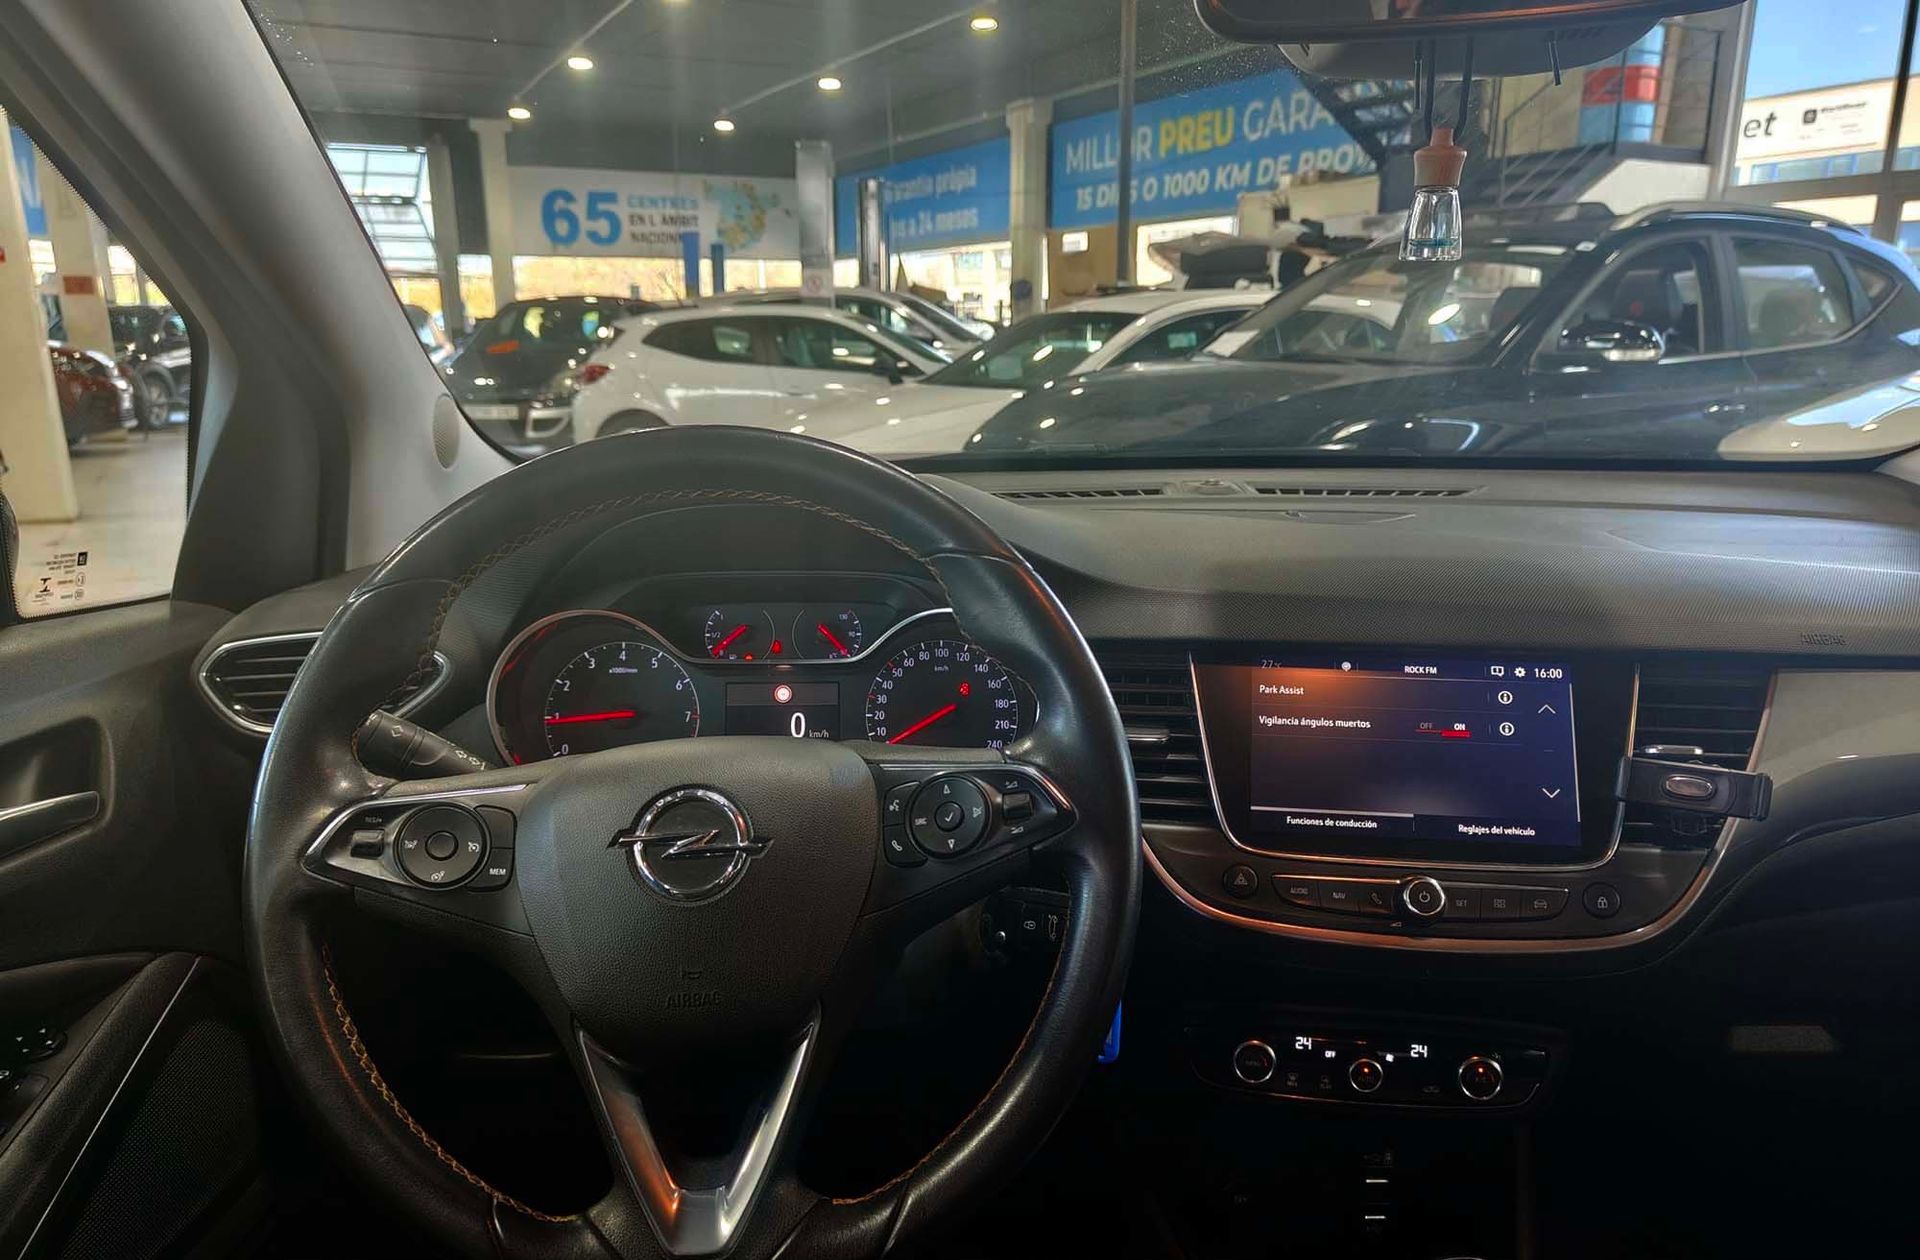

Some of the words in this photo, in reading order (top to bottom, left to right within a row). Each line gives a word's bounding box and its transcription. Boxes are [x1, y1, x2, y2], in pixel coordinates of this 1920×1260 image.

[1065, 126, 1153, 175] MILLR
[1159, 107, 1235, 158] PREU
[1164, 168, 1208, 199] 1000
[1214, 161, 1249, 190] KM
[1257, 155, 1291, 184] DE
[541, 188, 622, 246] 65
[619, 650, 626, 662] 4
[919, 651, 930, 661] 80
[935, 648, 949, 658] 100
[956, 652, 970, 662] 120
[588, 657, 596, 669] 3
[651, 657, 659, 669] 5
[904, 657, 915, 668] 60
[974, 663, 989, 673] 140
[892, 668, 903, 678] 50
[1404, 665, 1425, 674] ROCK
[1425, 666, 1437, 675] FM
[1534, 668, 1563, 679] 16:00
[563, 680, 571, 692] 2
[675, 680, 683, 691] 6
[882, 680, 893, 690] 40
[988, 679, 1001, 689] 160
[1259, 684, 1278, 695] Park
[1279, 685, 1304, 695] Assist
[876, 695, 888, 705] 30
[995, 698, 1009, 708] 180
[685, 711, 691, 723] 7
[874, 710, 885, 720] 20
[790, 712, 806, 738] 0
[809, 729, 829, 738] km/h
[995, 721, 1009, 731] 210
[1259, 715, 1299, 727] Vigilancia
[1300, 717, 1334, 729] ángulos
[1335, 719, 1371, 729] muertos
[1454, 723, 1466, 731] ON
[877, 727, 887, 736] 10
[562, 743, 569, 755] 0
[987, 740, 1003, 750] 240
[1286, 816, 1324, 827] Funciones
[1324, 818, 1335, 827] de
[1335, 818, 1377, 829] conducción
[1458, 823, 1490, 835] Reglajes
[1490, 825, 1503, 835] del
[1503, 826, 1535, 836] vehículo
[489, 867, 507, 876] MEM
[1295, 1036, 1312, 1050] 24
[1410, 1044, 1428, 1058] 24
